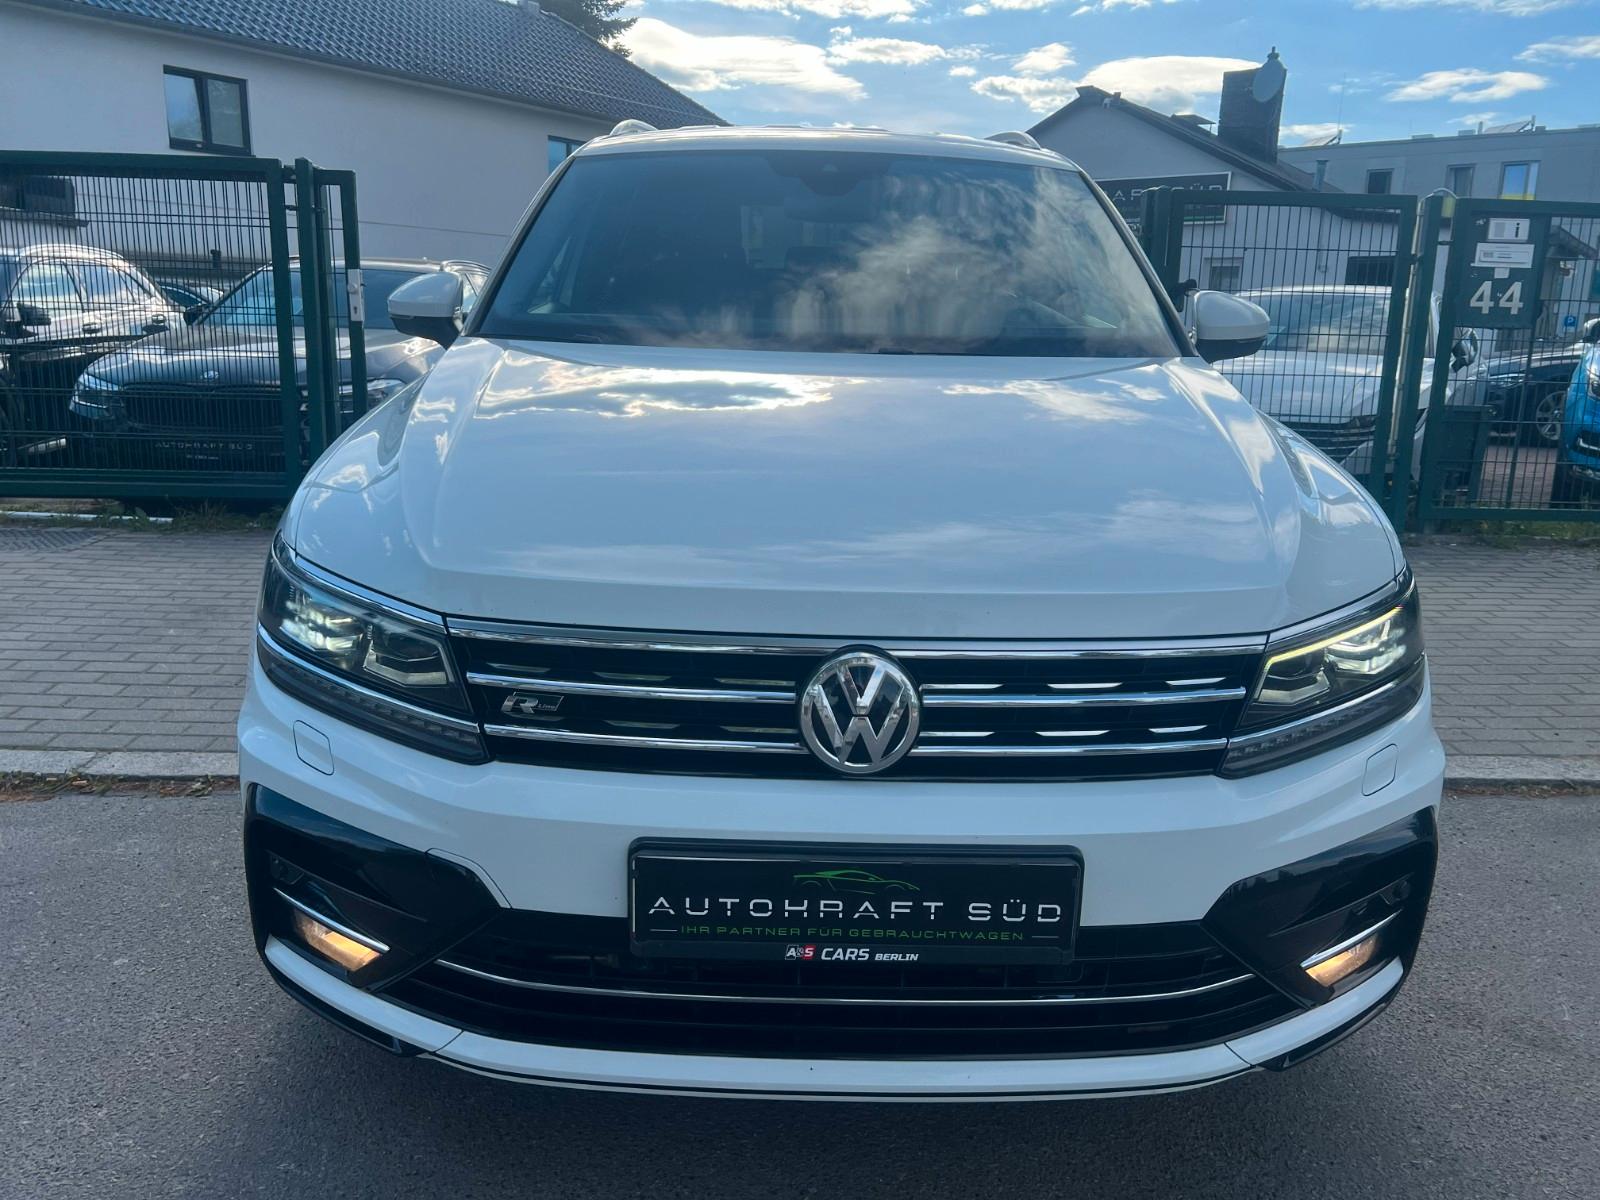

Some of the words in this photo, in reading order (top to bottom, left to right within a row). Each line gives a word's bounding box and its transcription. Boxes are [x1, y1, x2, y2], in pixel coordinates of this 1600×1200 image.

[1470, 280, 1523, 315] 44
[967, 899, 1061, 922] SÜD
[680, 925, 709, 934] IHR
[716, 926, 801, 936] PARTNER
[848, 929, 1024, 940] GEBRAUCHTWAGEN
[821, 947, 870, 961] CARS
[874, 953, 919, 961] BERLIN
